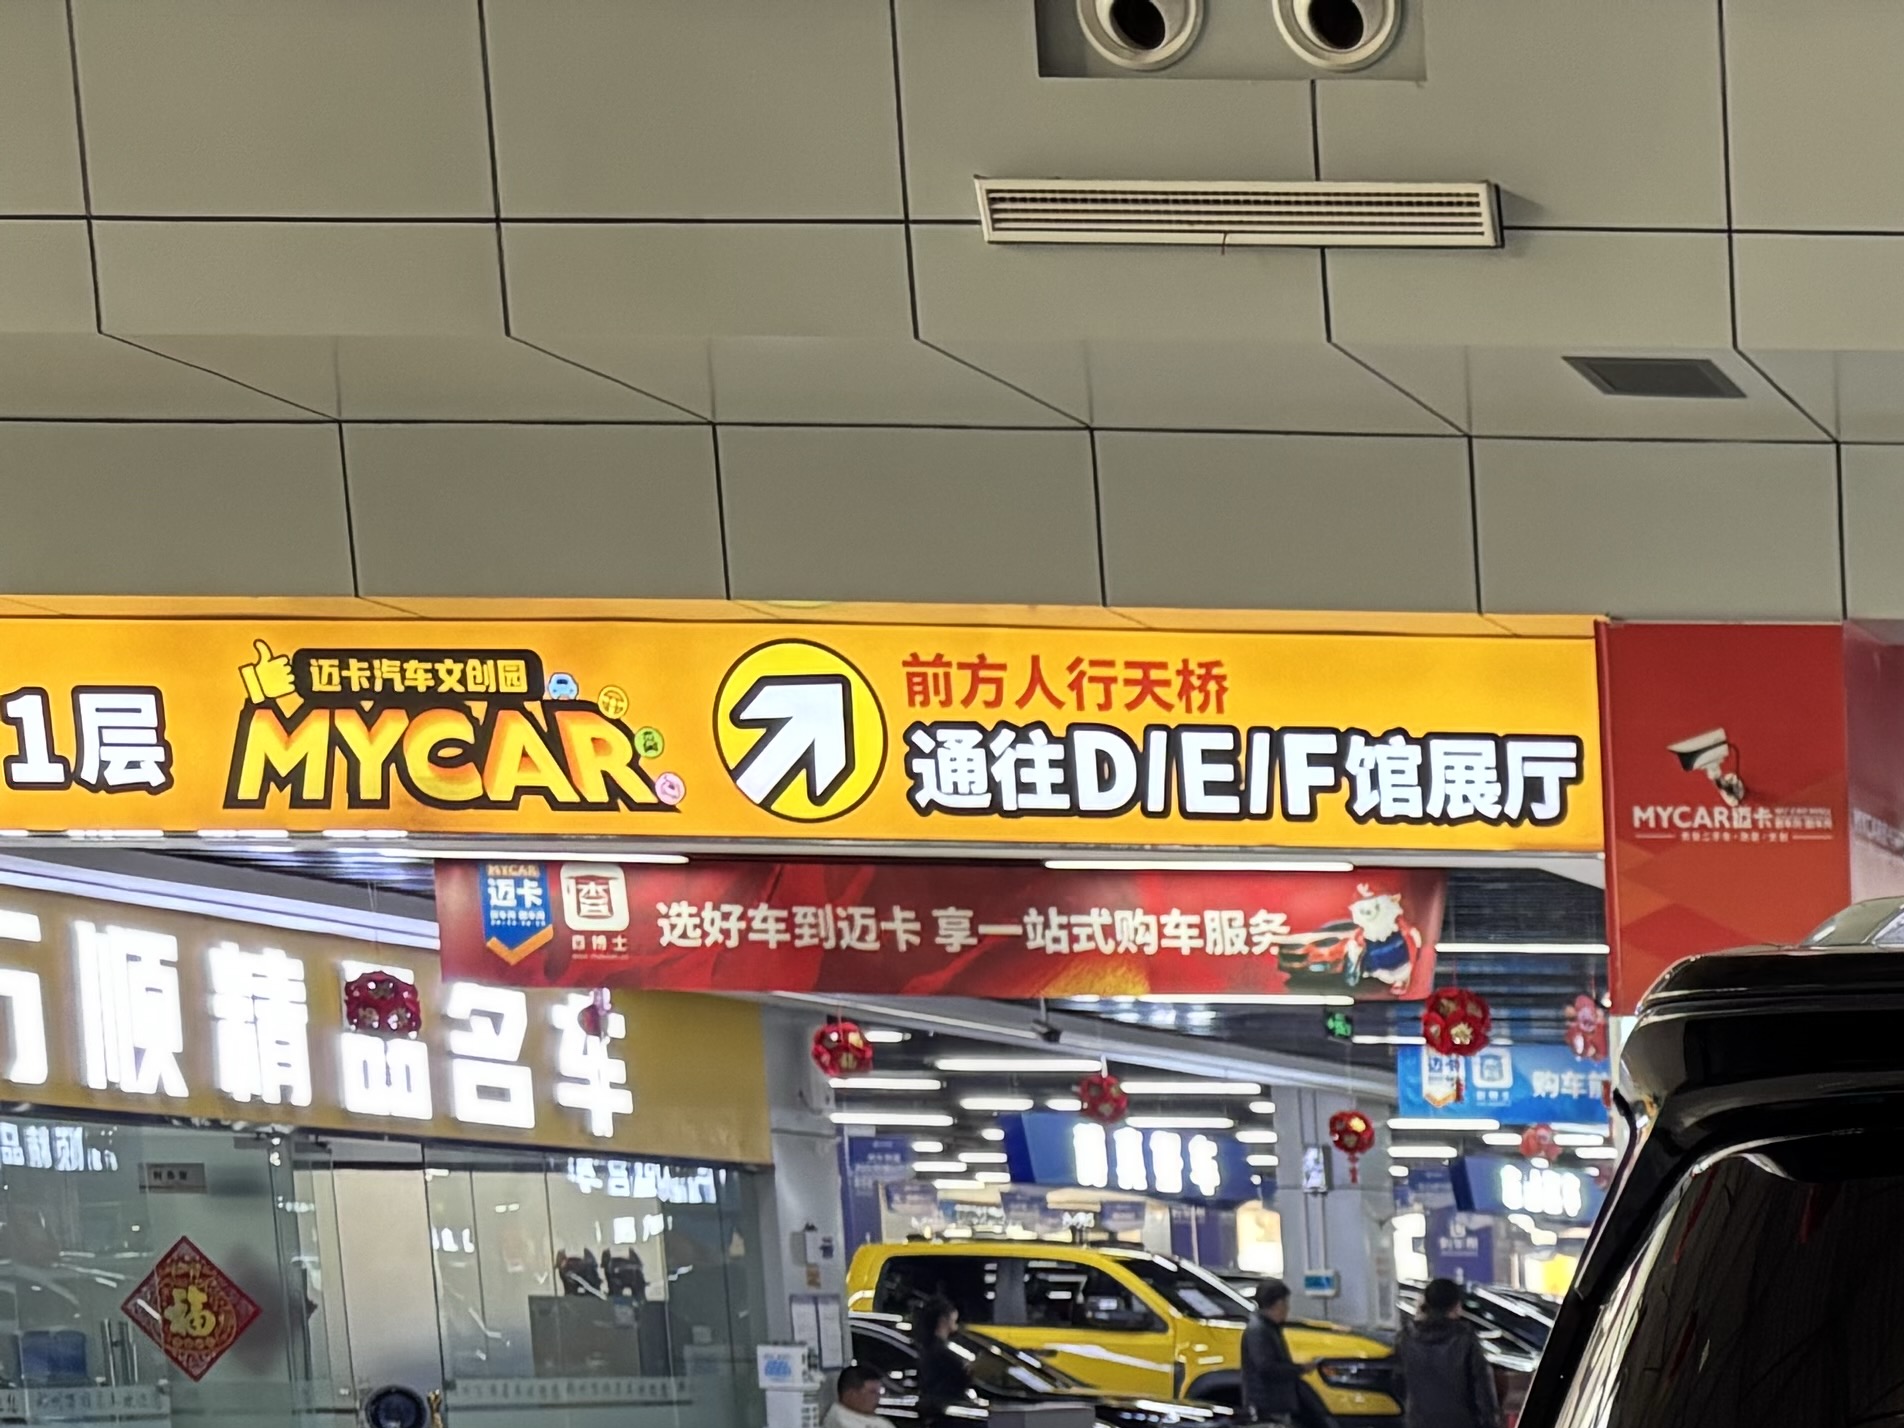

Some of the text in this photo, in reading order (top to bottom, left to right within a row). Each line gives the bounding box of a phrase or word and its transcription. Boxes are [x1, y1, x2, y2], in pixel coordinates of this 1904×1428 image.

[308, 657, 528, 695] 迈卡汽车文创园
[902, 652, 1229, 715] 前方人行天桥
[3, 690, 170, 790] 1层
[235, 702, 660, 806] MYCAR
[911, 726, 1579, 822] 通往D/E/F馆展厅
[487, 878, 543, 908] 迈卡
[655, 899, 1292, 961] 选好车到迈卡 享一站式购车服务
